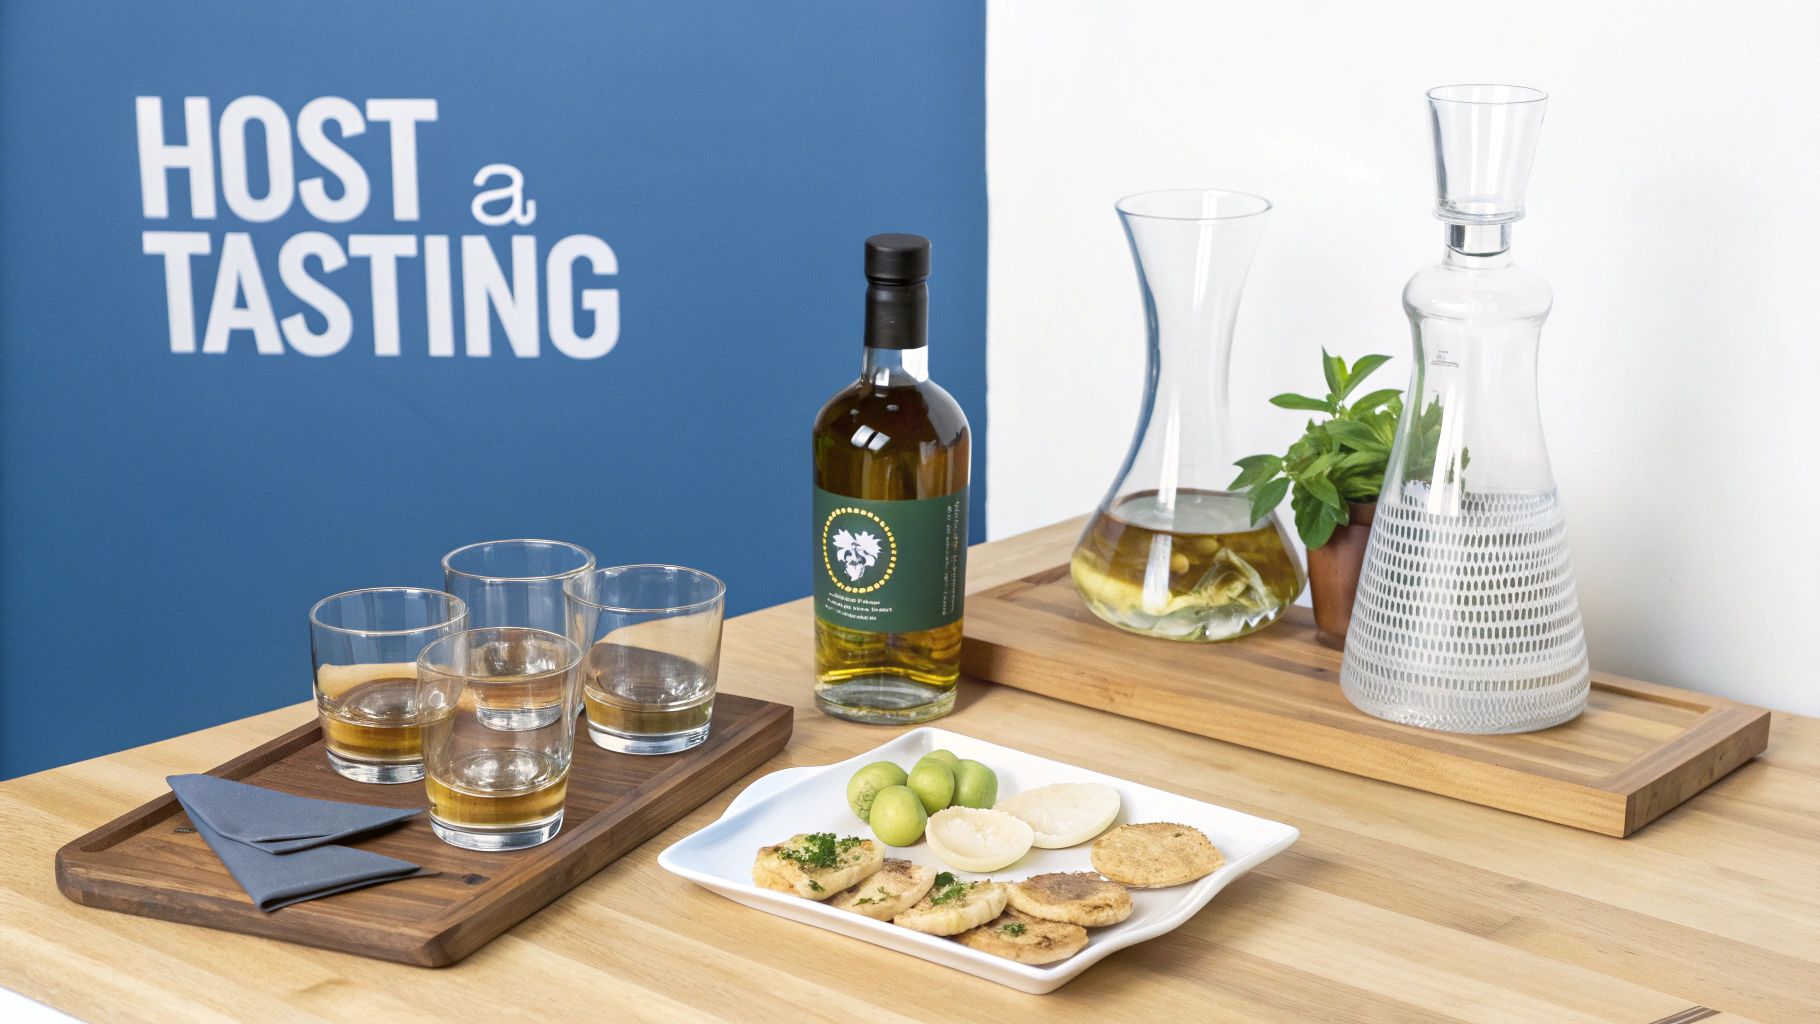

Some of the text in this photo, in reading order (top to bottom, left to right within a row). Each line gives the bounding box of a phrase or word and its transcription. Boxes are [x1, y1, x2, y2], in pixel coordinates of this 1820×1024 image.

[136, 95, 537, 226] HOST a
[142, 231, 620, 359] TASTING
